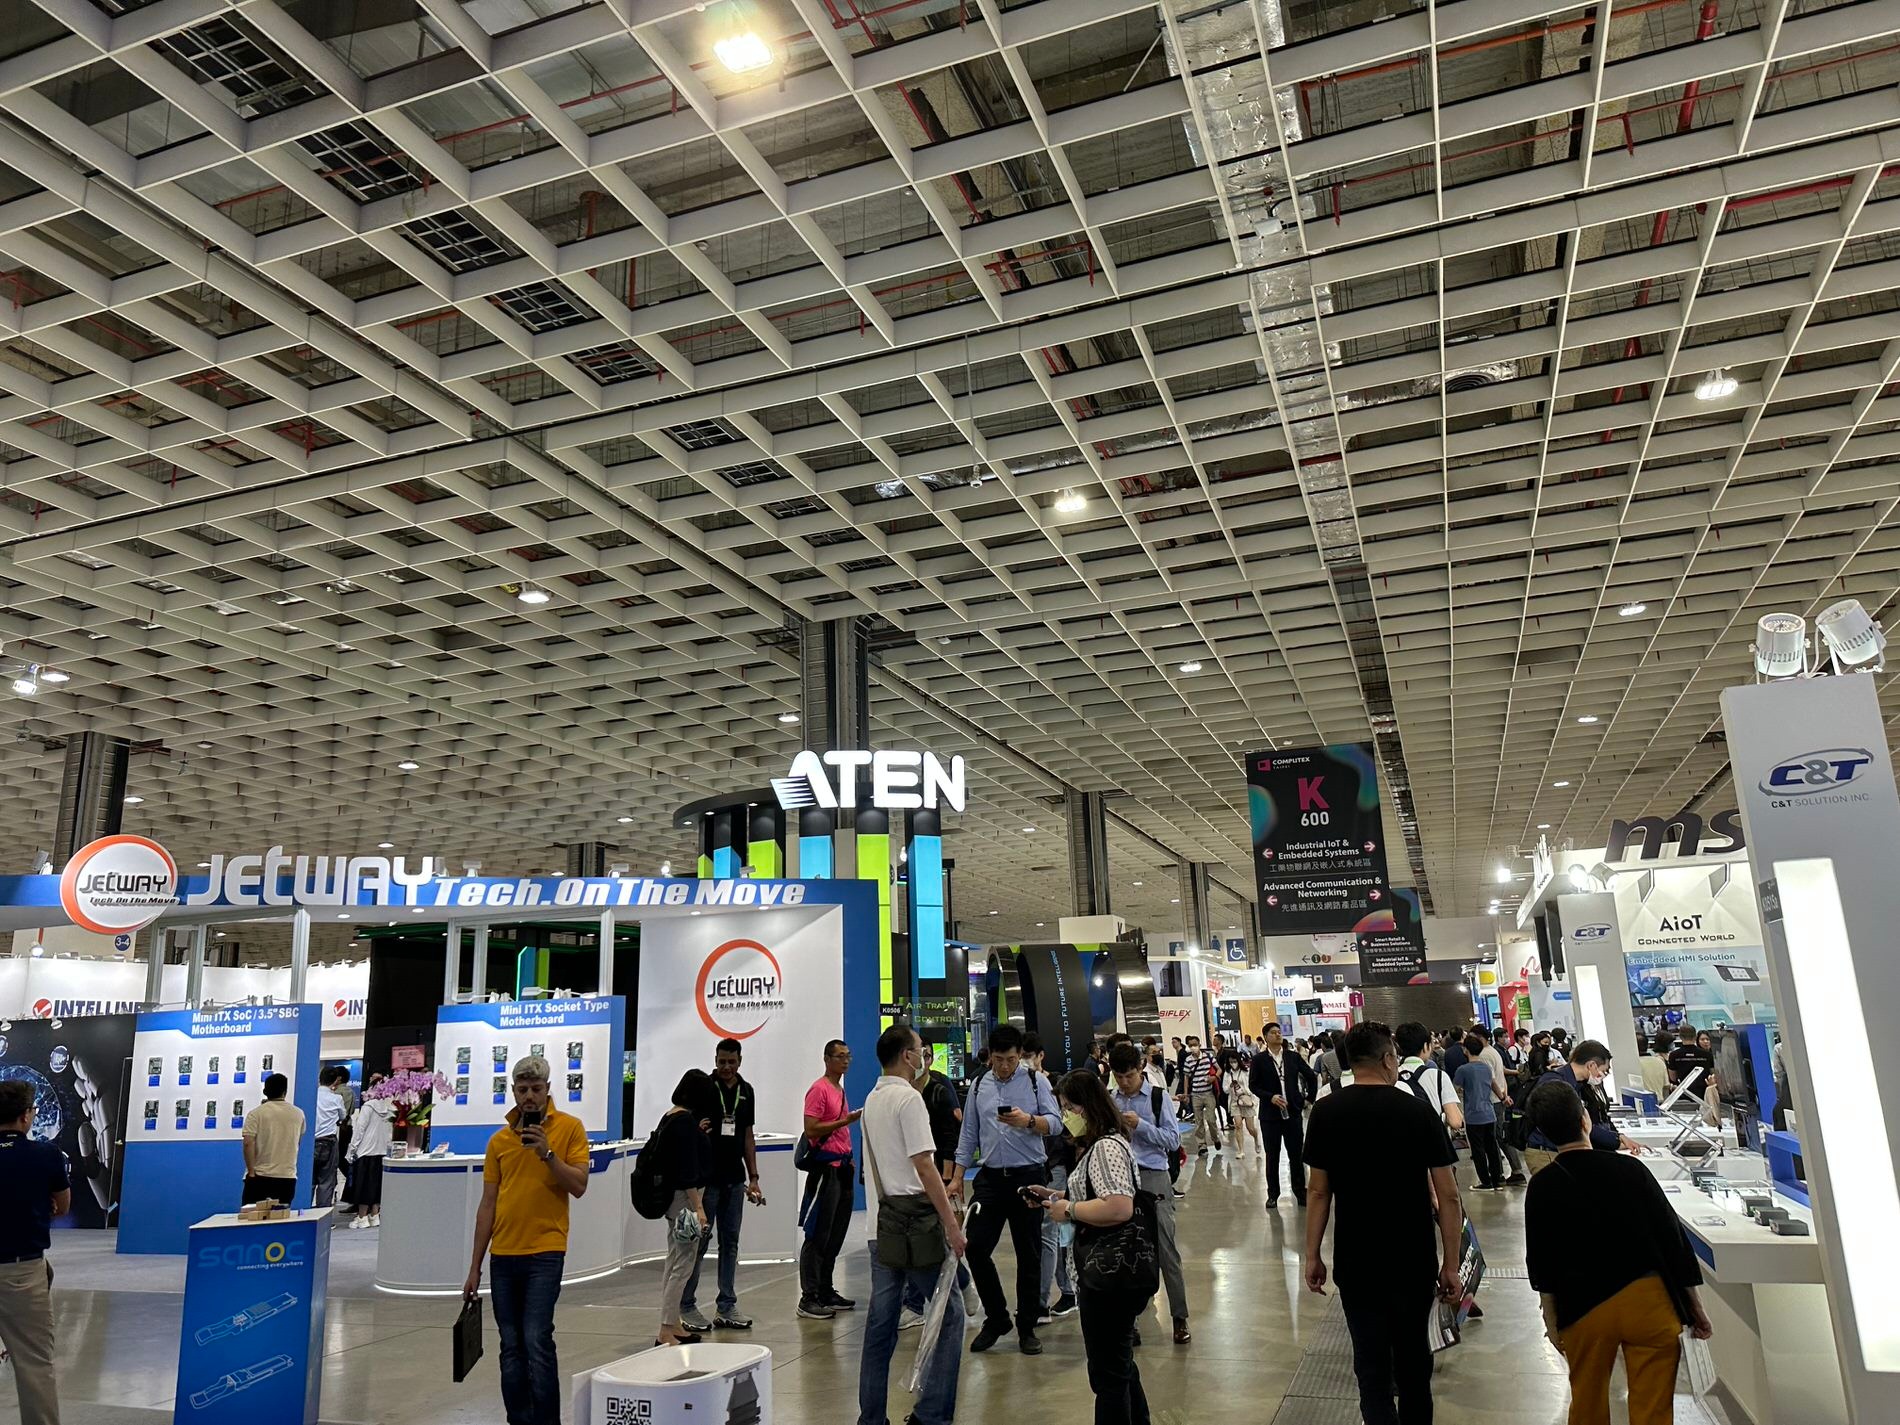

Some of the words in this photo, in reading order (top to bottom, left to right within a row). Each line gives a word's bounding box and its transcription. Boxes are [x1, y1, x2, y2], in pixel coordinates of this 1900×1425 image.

[1272, 756, 1310, 765] COMPUTEX
[1769, 758, 1869, 786] C&T
[770, 750, 965, 812] ATEN
[1297, 776, 1330, 811] K
[1771, 799, 1792, 809] C&T
[1795, 795, 1847, 807] SOLUTION
[1301, 811, 1330, 827] 600
[1286, 840, 1326, 850] Industrial
[1327, 839, 1341, 848] IoT
[1342, 839, 1350, 847] &
[1278, 849, 1323, 860] Embedded
[1324, 848, 1360, 859] Systems
[1264, 881, 1304, 891] Advanced
[1306, 877, 1373, 888] Communication
[1374, 876, 1382, 885] &
[611, 879, 690, 906] The
[693, 879, 806, 905] Move
[1297, 888, 1348, 898] Networking
[1574, 926, 1613, 938] C&T
[1628, 955, 1676, 965] Embedded
[1698, 953, 1736, 962] Solution
[500, 1005, 522, 1015] Mini
[524, 1004, 543, 1014] ITX
[545, 1002, 581, 1013] Socket
[584, 1000, 610, 1013] Type
[1058, 986, 1068, 1017] FUTURE
[214, 1010, 232, 1022] ITX
[233, 1009, 252, 1020] SoC
[253, 1009, 257, 1020] /
[278, 1006, 300, 1019] SBC
[500, 1013, 565, 1027] Motherboard
[191, 1022, 252, 1035] Motherboard
[1063, 1020, 1069, 1032] TO
[269, 1260, 304, 1268] everywhere
